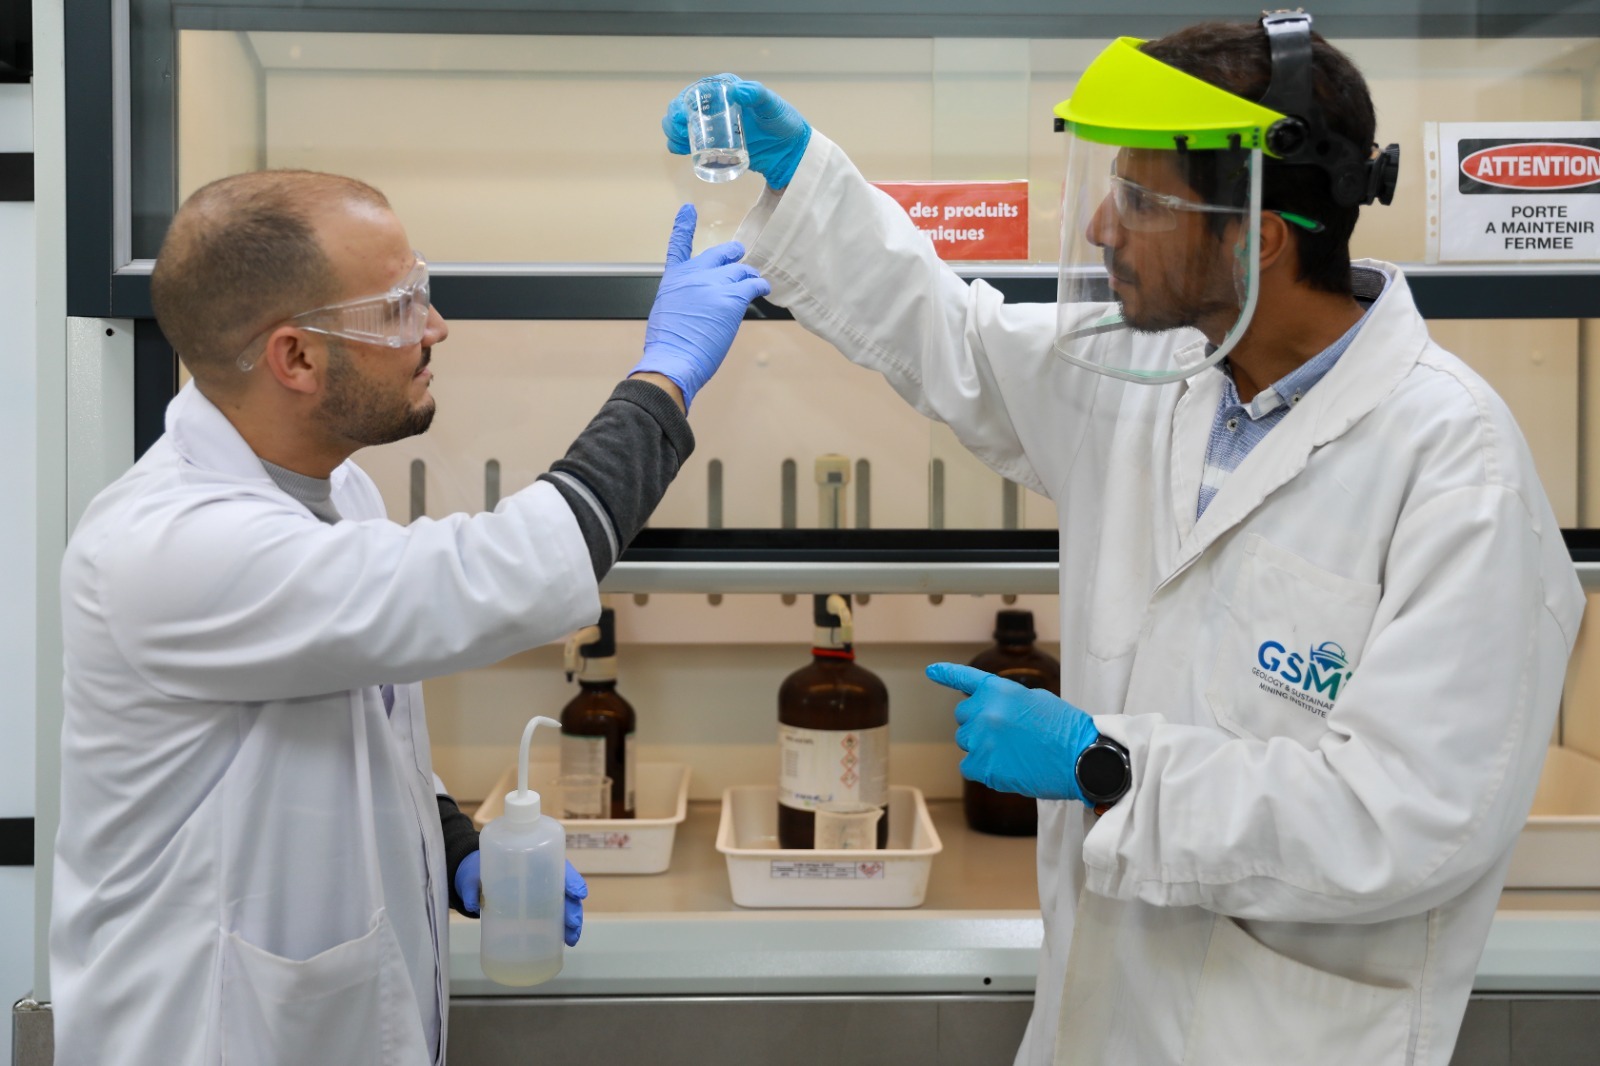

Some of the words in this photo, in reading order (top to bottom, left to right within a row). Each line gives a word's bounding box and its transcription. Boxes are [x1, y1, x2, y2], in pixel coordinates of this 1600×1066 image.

[1476, 155, 1600, 176] ATTENTION
[909, 202, 938, 218] des
[944, 202, 1018, 221] produits
[1511, 205, 1568, 218] PORTE
[1485, 221, 1497, 234] A
[1501, 221, 1595, 234] MAINTENIR
[1504, 237, 1574, 250] FERMEE
[1251, 666, 1284, 688] GEOLOGY
[1284, 684, 1291, 692] &
[1259, 682, 1289, 700] MINING
[1289, 695, 1327, 719] INSTITUTE
